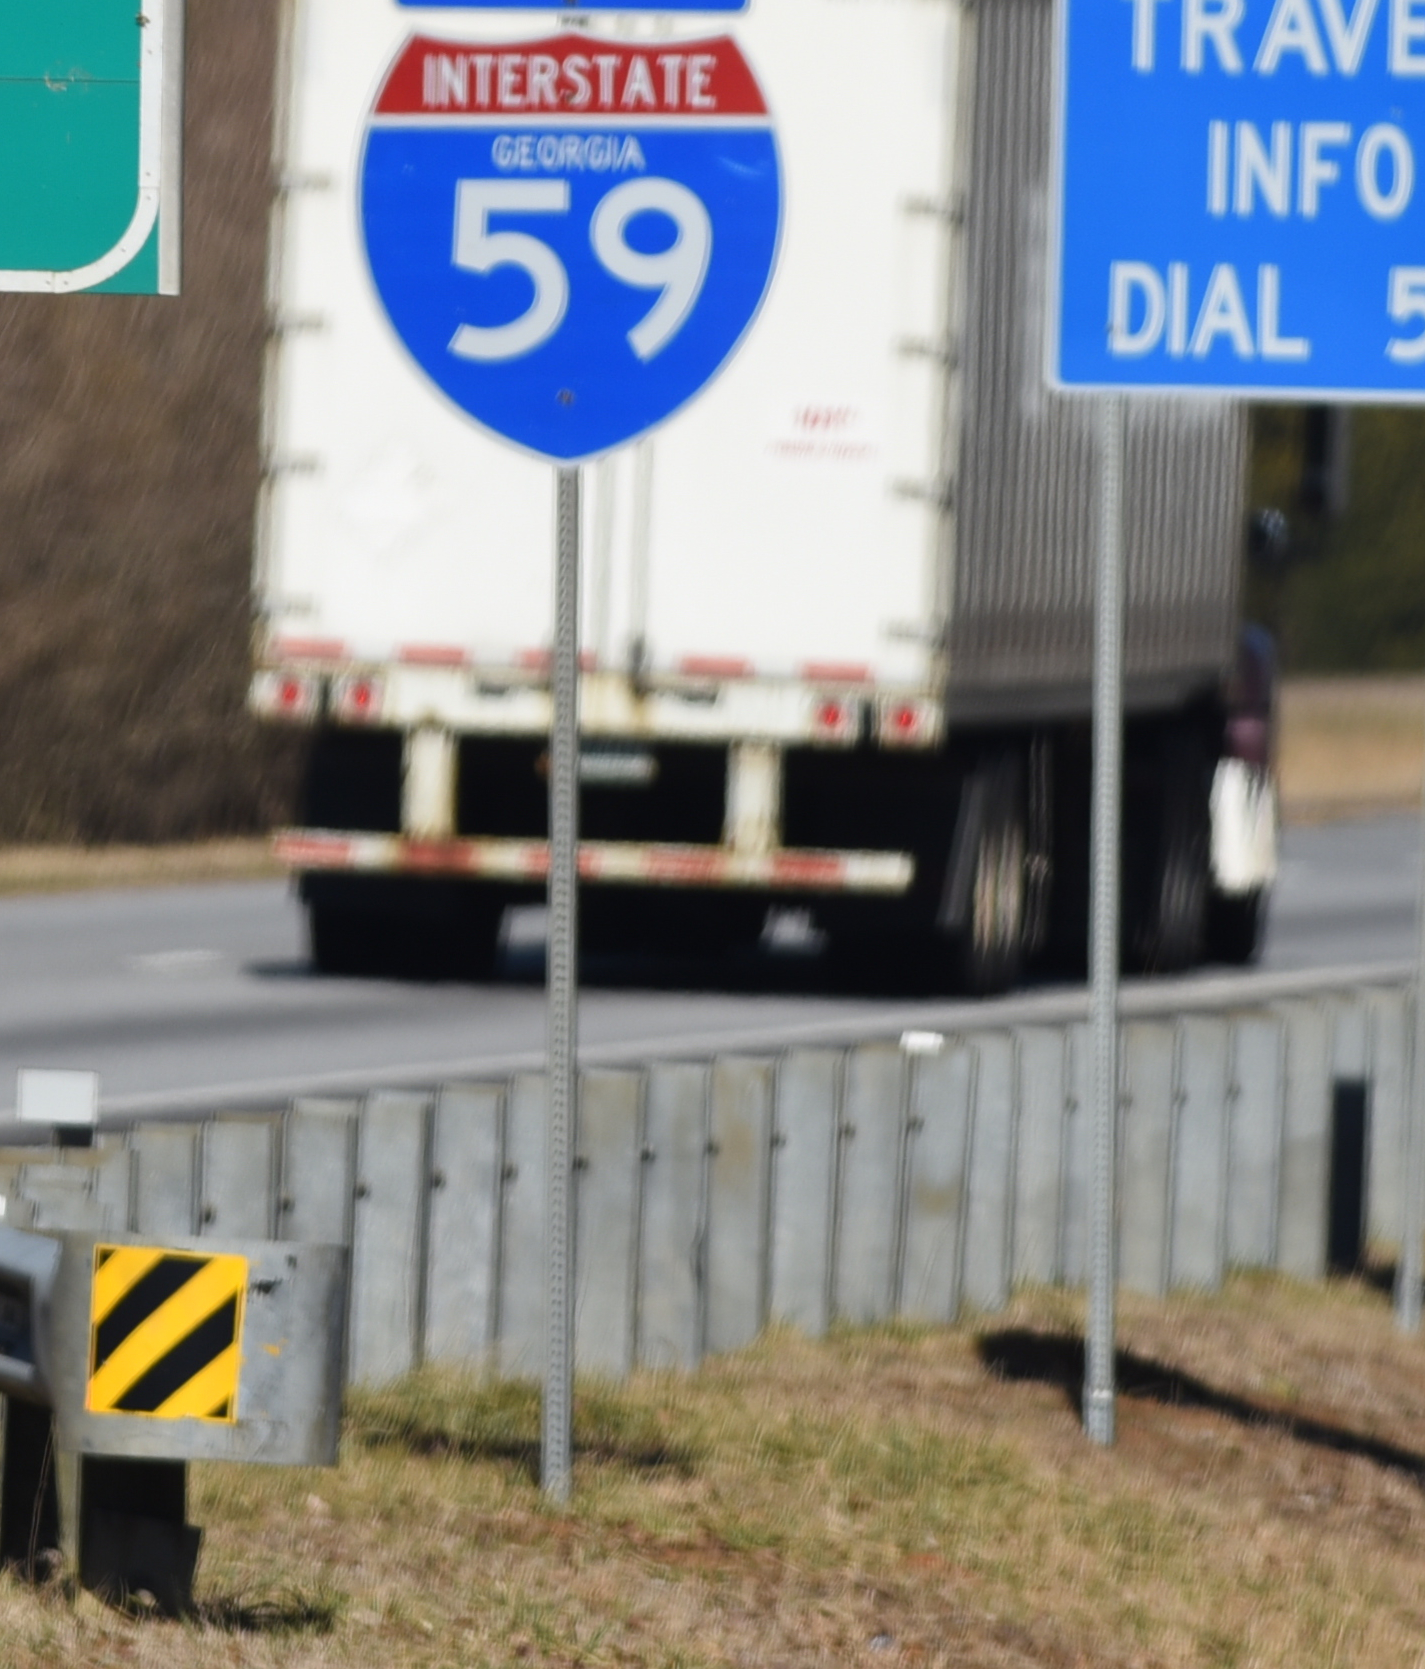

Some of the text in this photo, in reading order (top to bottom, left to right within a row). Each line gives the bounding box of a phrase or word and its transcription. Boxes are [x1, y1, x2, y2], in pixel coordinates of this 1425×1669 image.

[422, 52, 718, 108] INTERSTATE
[491, 135, 646, 171] GEORGIA
[1205, 121, 1416, 219] INFO
[447, 176, 713, 364] 59
[1107, 261, 1310, 360] DIAL
